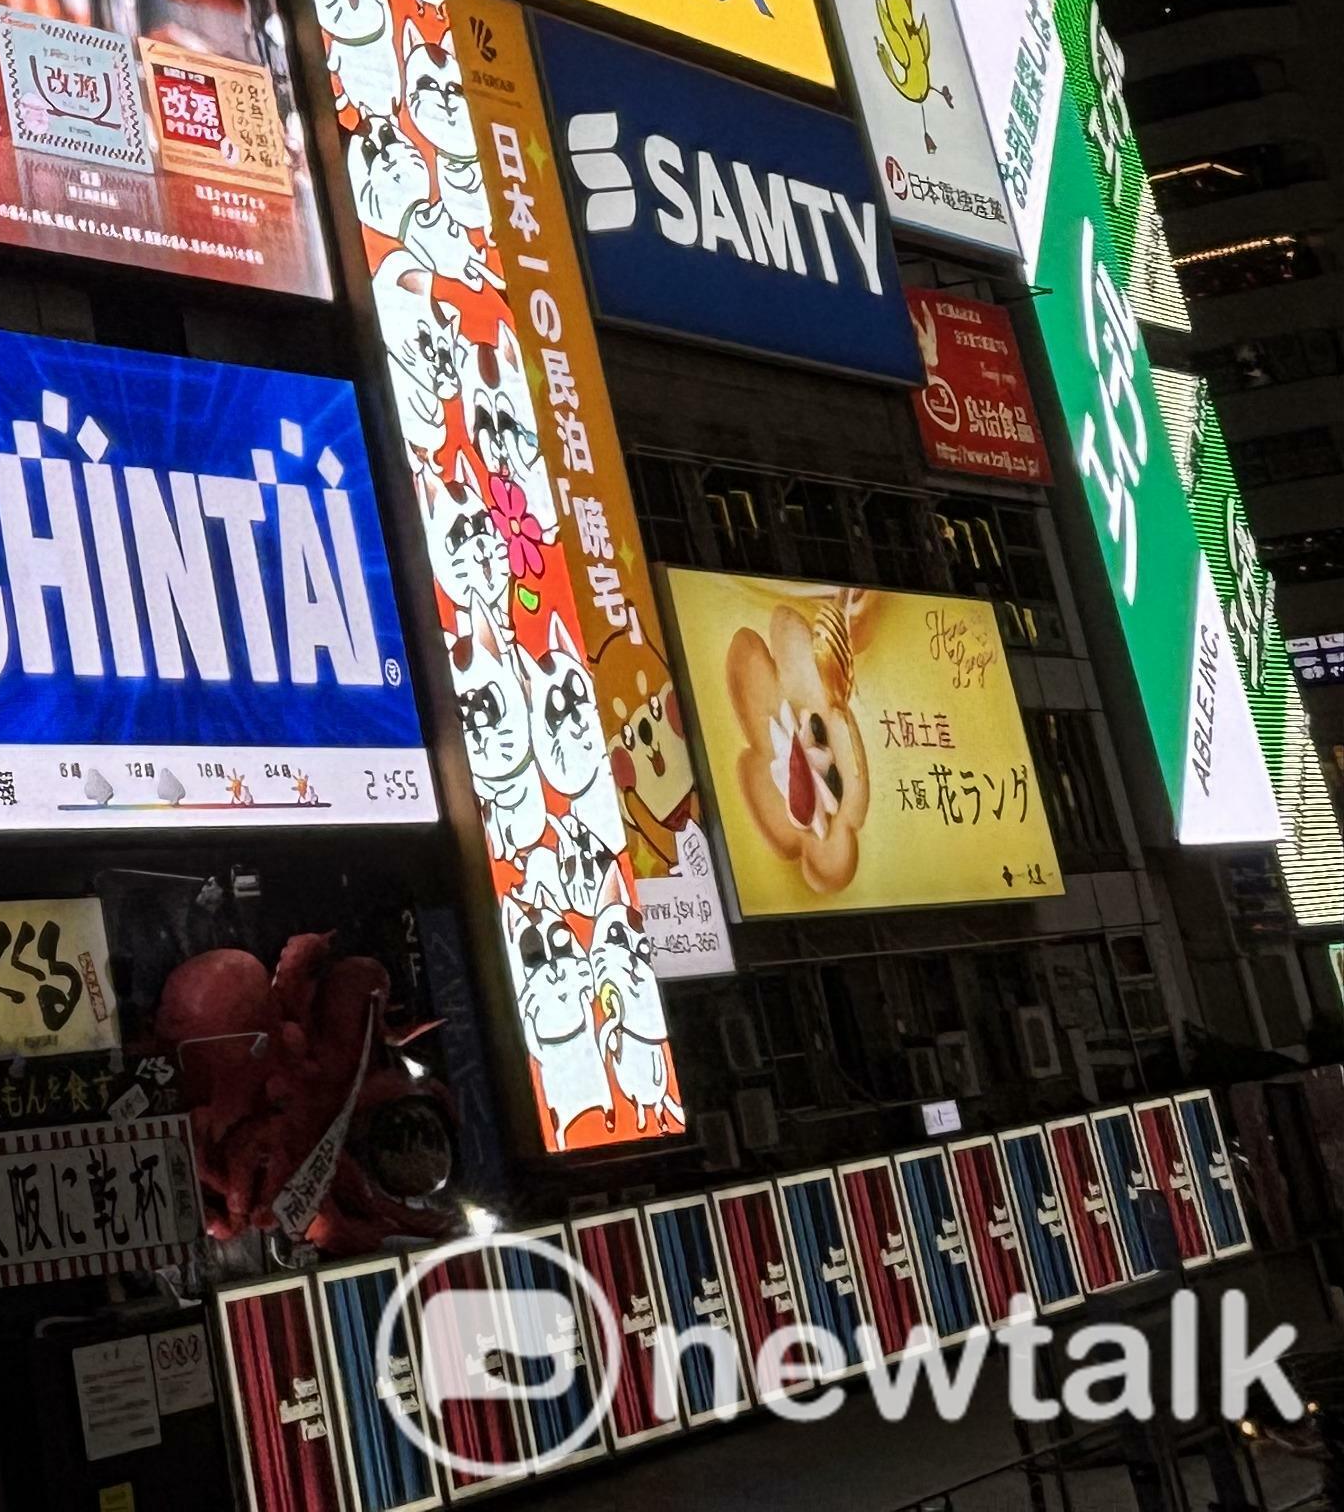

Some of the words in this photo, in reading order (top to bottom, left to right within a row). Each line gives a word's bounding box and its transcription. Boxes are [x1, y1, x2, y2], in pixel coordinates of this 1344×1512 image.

[643, 134, 884, 296] SAMTY
[878, 709, 956, 750] 大阪土産
[928, 763, 1031, 827] 花ラング
